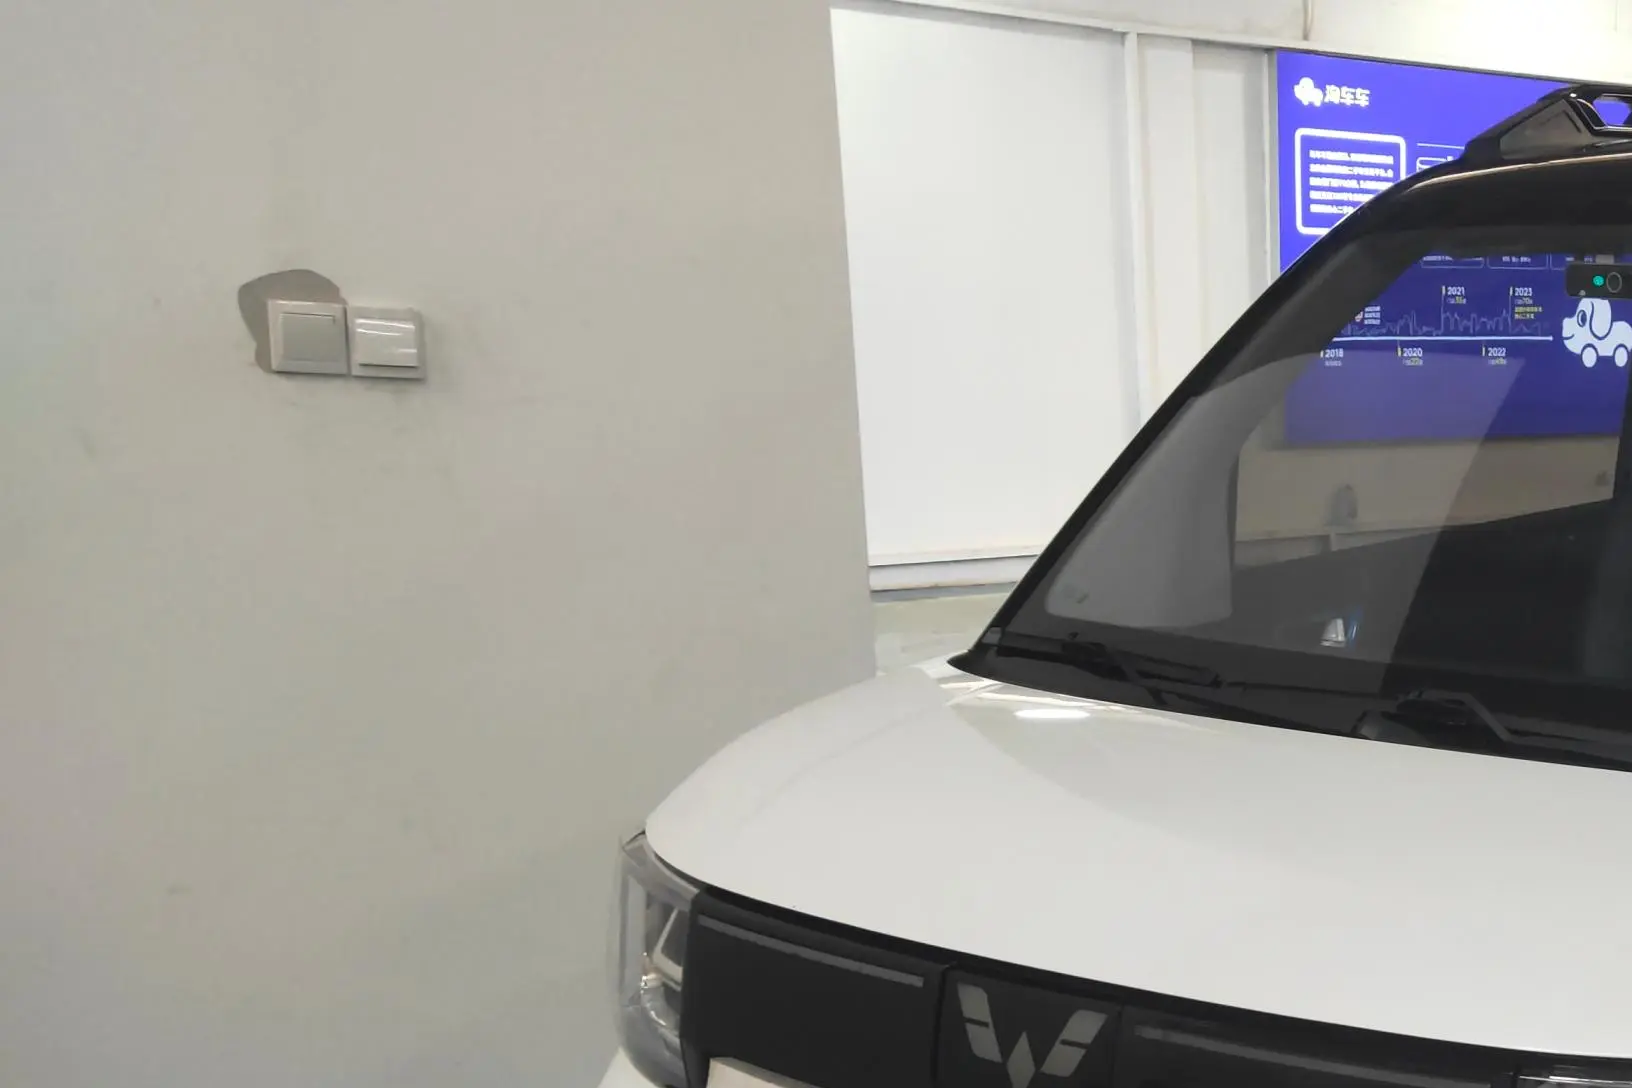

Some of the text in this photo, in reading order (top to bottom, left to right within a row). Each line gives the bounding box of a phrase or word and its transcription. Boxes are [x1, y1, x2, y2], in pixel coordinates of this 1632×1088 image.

[1447, 286, 1466, 296] 2021
[1324, 348, 1344, 358] 2018
[1403, 347, 1423, 358] 2020
[1487, 347, 1507, 357] 2022
